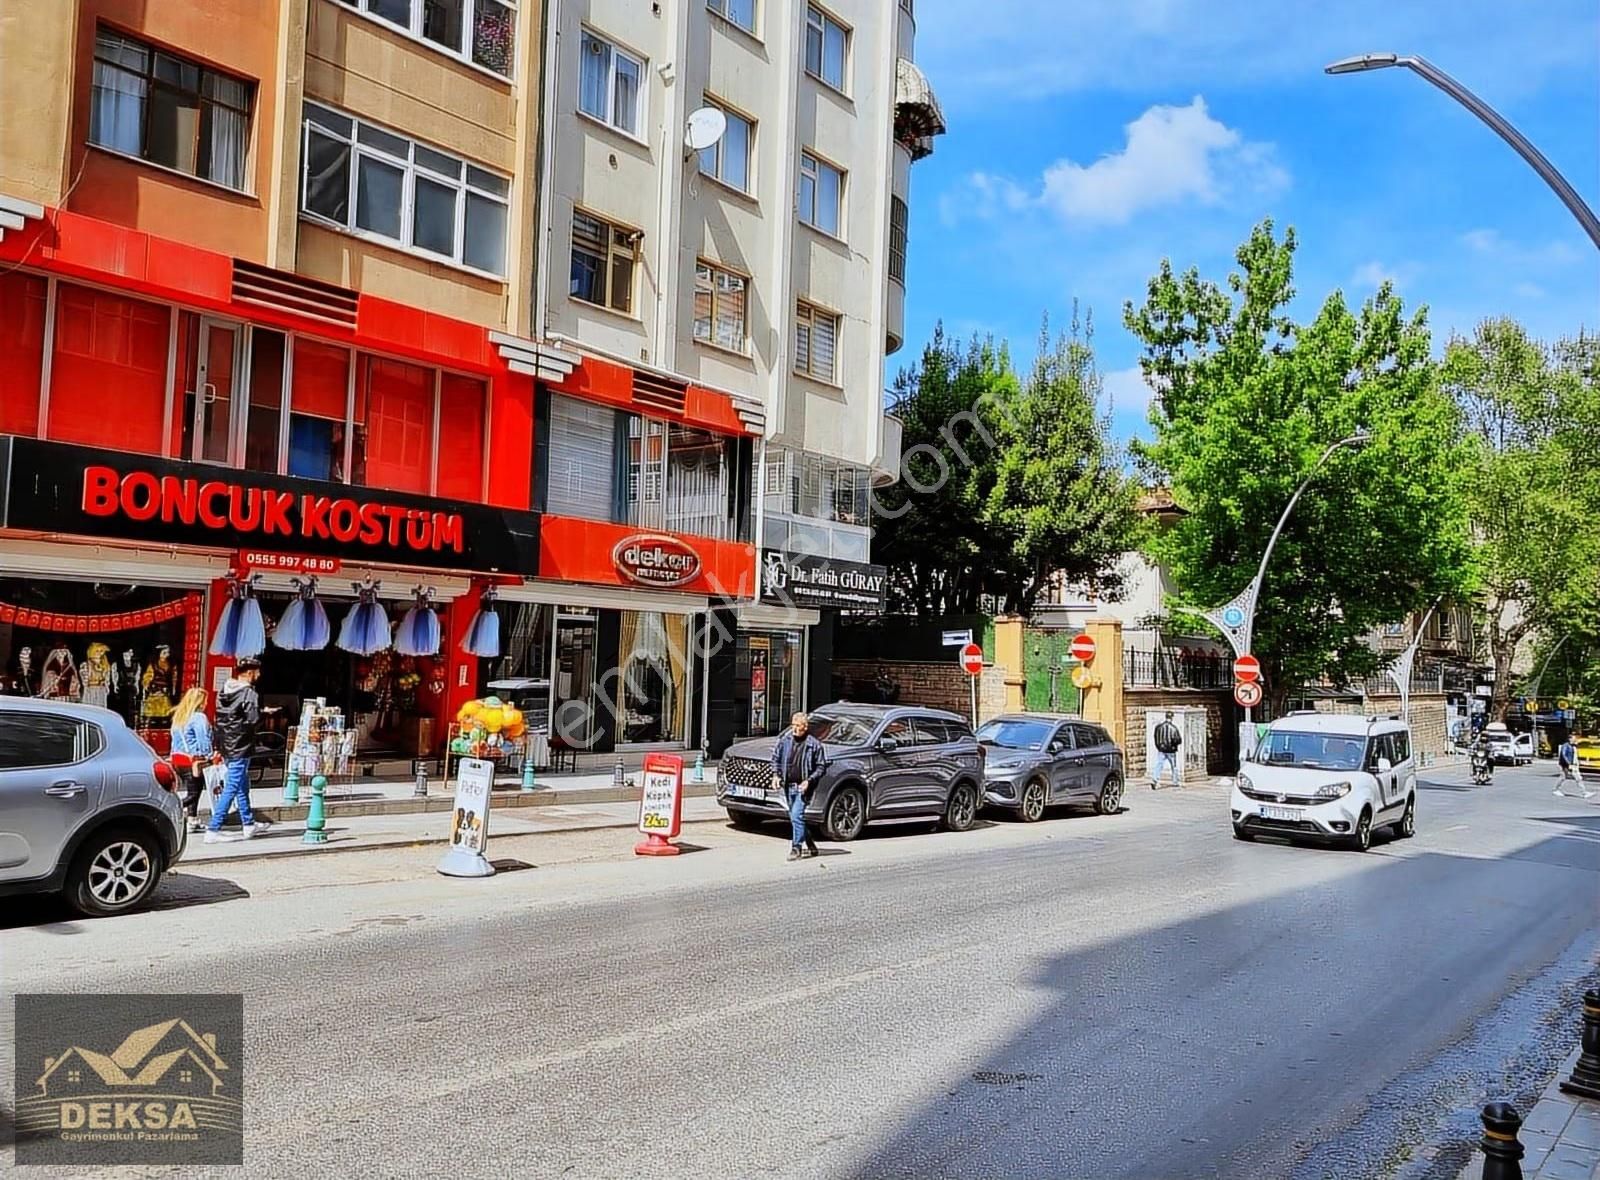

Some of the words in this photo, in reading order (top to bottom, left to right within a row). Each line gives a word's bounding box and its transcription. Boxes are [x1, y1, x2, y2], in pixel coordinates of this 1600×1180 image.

[82, 466, 293, 536] BONCUK
[302, 495, 464, 552] KOSTÜM
[247, 553, 276, 565] 0555
[279, 556, 300, 567] 997
[791, 565, 808, 583] Dr.
[811, 567, 838, 586] Fatih
[840, 570, 883, 591] GÜRAY
